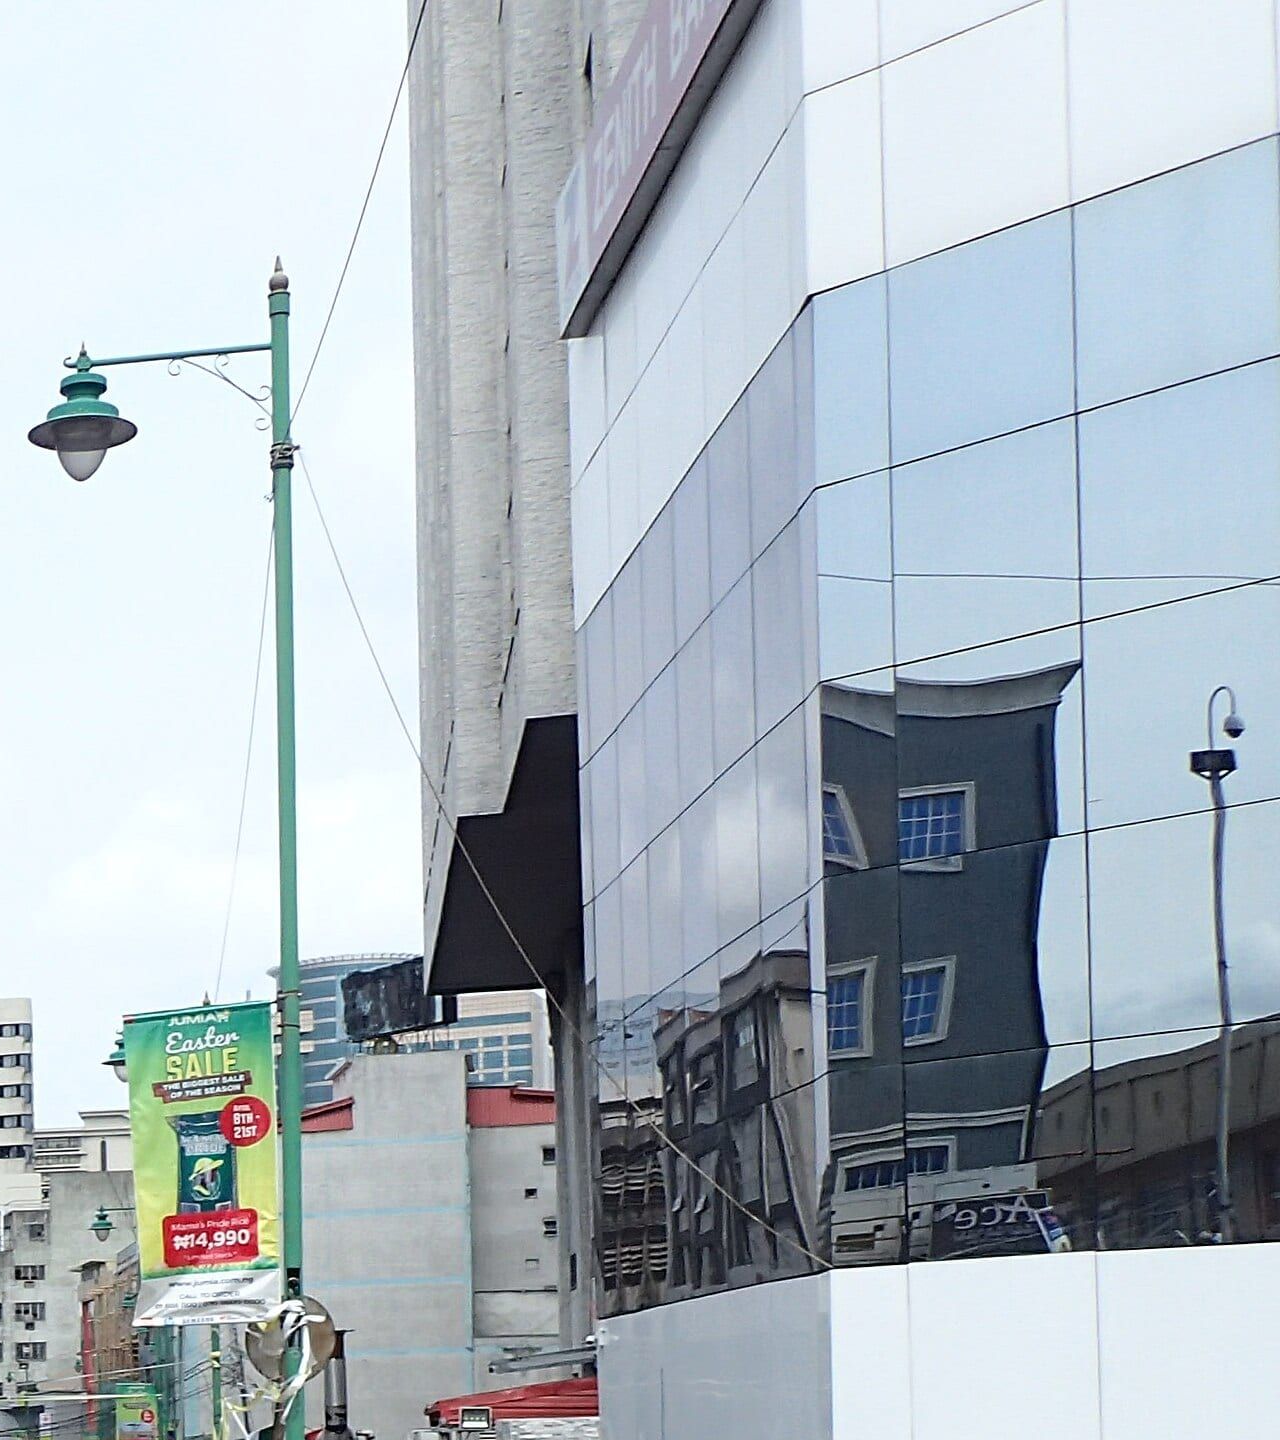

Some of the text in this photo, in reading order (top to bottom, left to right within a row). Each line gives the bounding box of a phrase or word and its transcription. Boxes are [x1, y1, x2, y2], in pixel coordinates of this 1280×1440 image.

[165, 1026, 240, 1054] Easter
[166, 1047, 238, 1081] SALE
[222, 1074, 246, 1083] SALE
[204, 1084, 241, 1095] SEASON
[234, 1126, 258, 1138] 21ST
[207, 1218, 231, 1229] Pride
